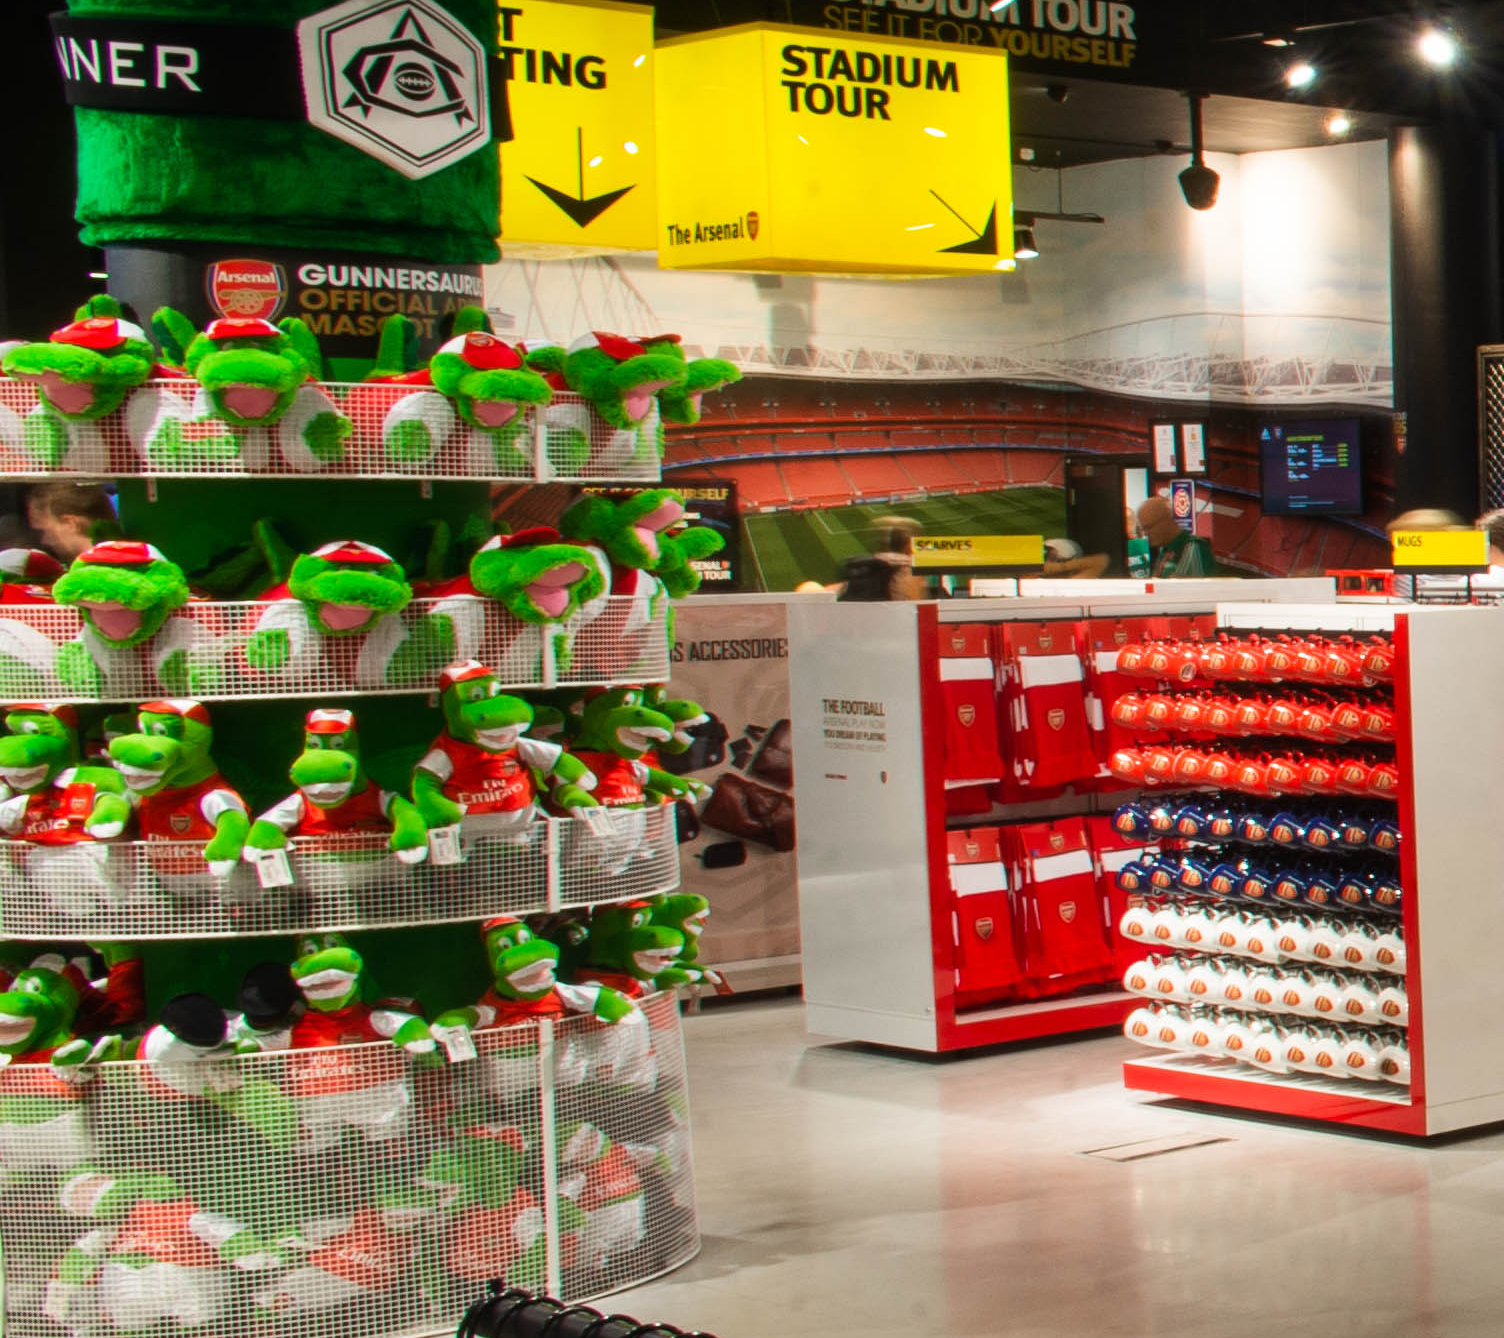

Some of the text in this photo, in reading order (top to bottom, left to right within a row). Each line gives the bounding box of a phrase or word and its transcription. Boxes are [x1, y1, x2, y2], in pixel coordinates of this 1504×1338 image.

[989, 26, 1136, 69] YOURSELF
[781, 43, 960, 93] STADIUM
[781, 79, 891, 121] TOUR
[667, 215, 744, 248] The Arsenal
[218, 270, 277, 285] Arsenal
[300, 287, 438, 316] OFFICIAL
[915, 540, 973, 553] SCARVES
[1397, 535, 1423, 547] MUGS
[482, 778, 507, 790] Fly
